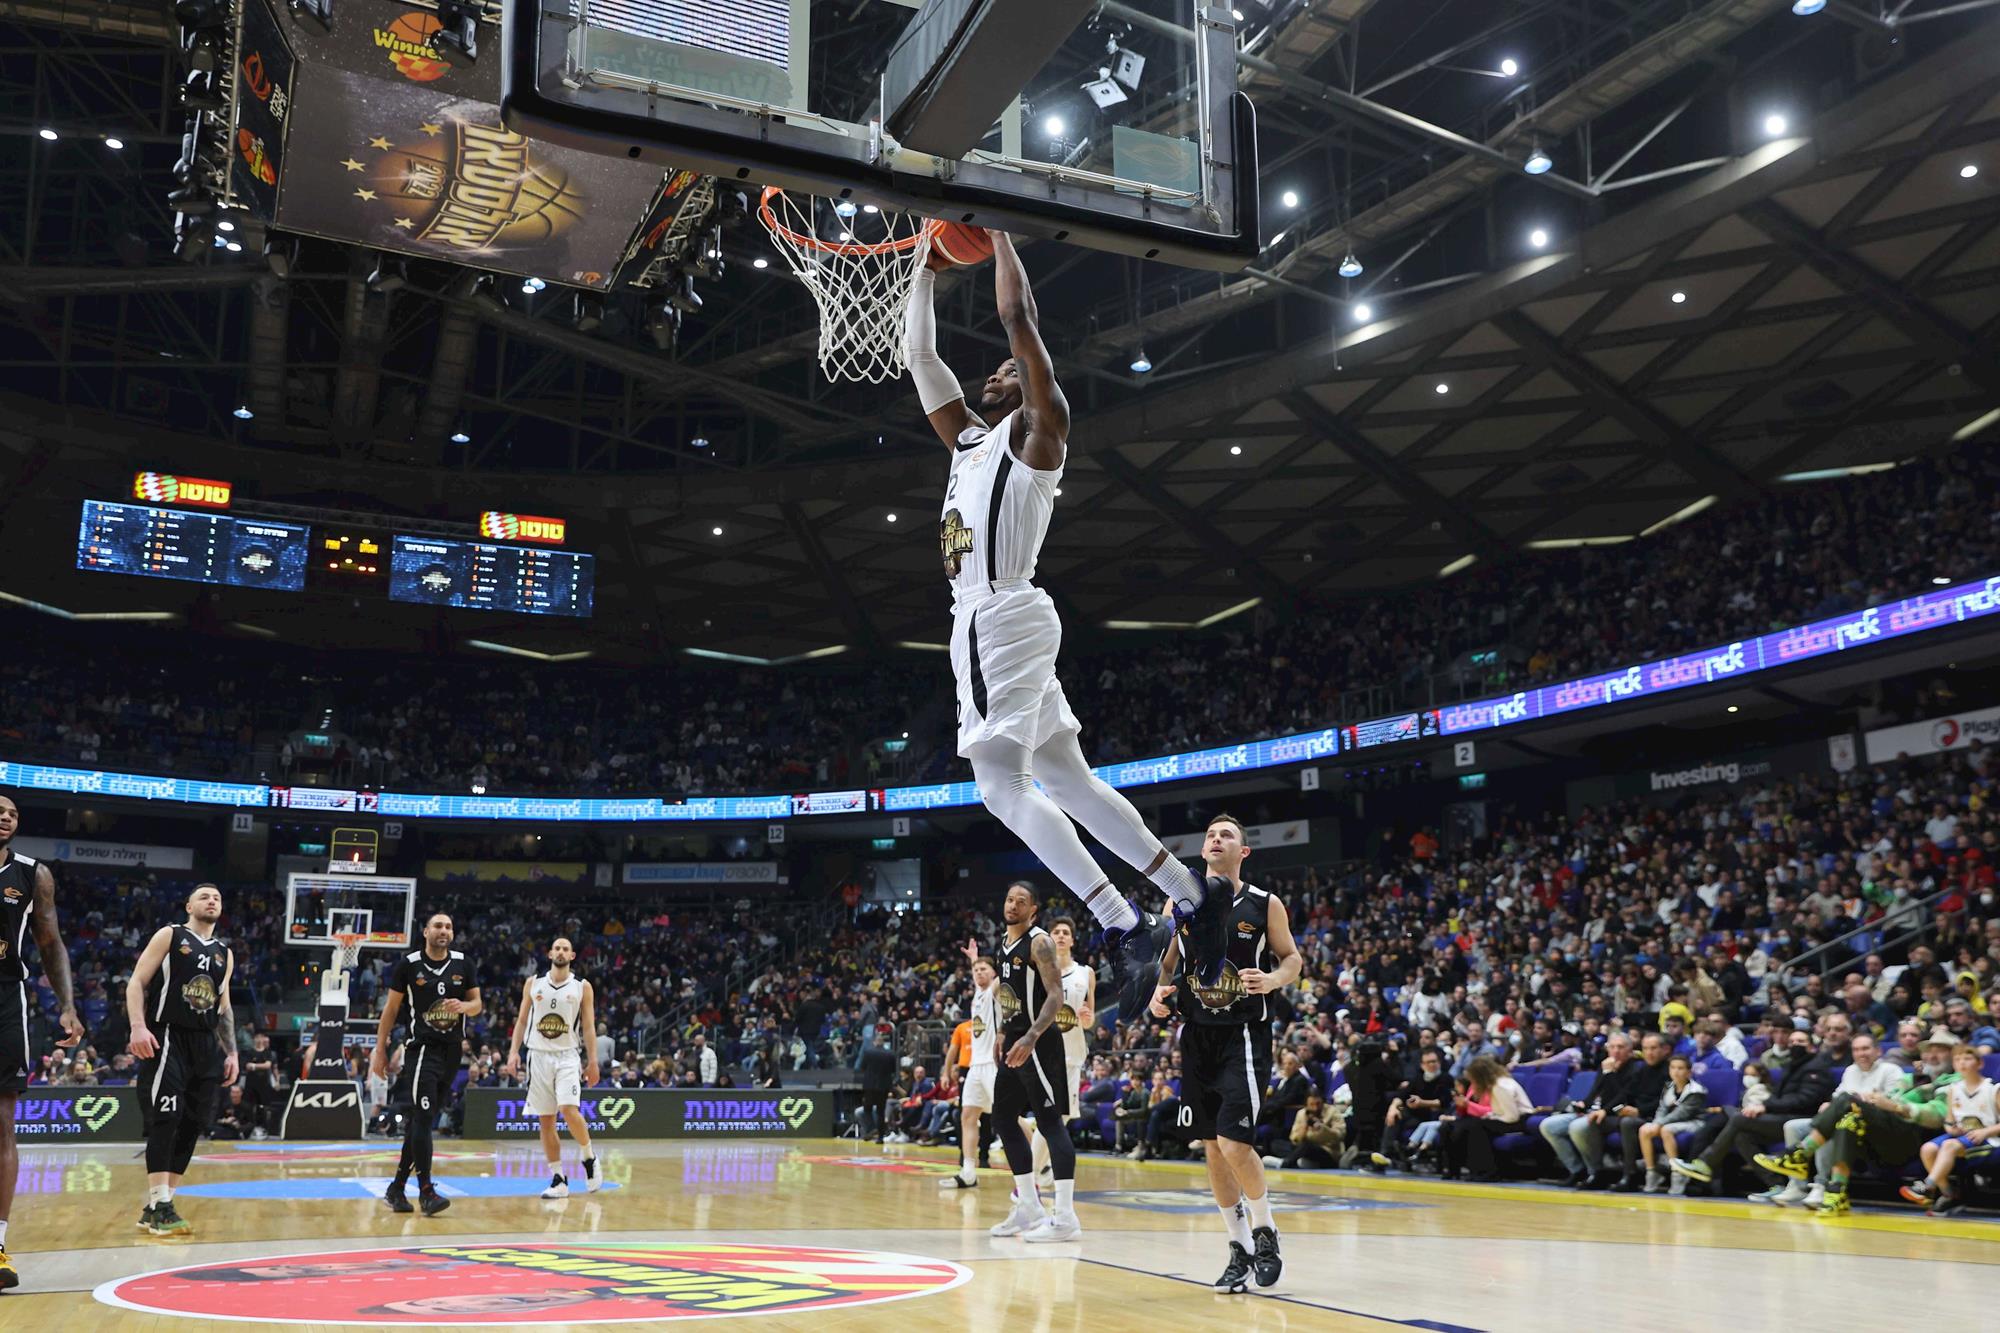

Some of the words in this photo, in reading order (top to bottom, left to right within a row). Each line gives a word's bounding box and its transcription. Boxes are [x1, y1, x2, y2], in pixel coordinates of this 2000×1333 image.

[373, 28, 443, 60] Winne
[408, 161, 446, 199] 2022
[179, 482, 230, 504] טוטו
[948, 474, 958, 501] 2
[520, 520, 565, 540] טוטו
[1962, 718, 2000, 736] Play
[1460, 748, 1469, 760] 2
[1307, 773, 1313, 785] 1
[1651, 760, 1771, 791] Investing.com
[270, 788, 288, 807] 11
[358, 794, 377, 812] 12
[792, 796, 809, 815] 12
[870, 791, 879, 810] 1
[237, 816, 249, 830] 11
[388, 825, 401, 836] 12
[898, 822, 904, 833] 1
[770, 828, 782, 839] 12
[197, 953, 210, 970] 21
[1002, 962, 1010, 978] 19
[437, 982, 446, 995] 6
[551, 998, 557, 1009] 8
[315, 1058, 342, 1067] KIA
[160, 1095, 178, 1112] 21
[294, 1092, 357, 1108] KIA
[421, 1096, 430, 1109] 6
[684, 1100, 778, 1119] אשמורת
[1177, 1104, 1193, 1127] 10
[417, 1247, 836, 1310] Winner
